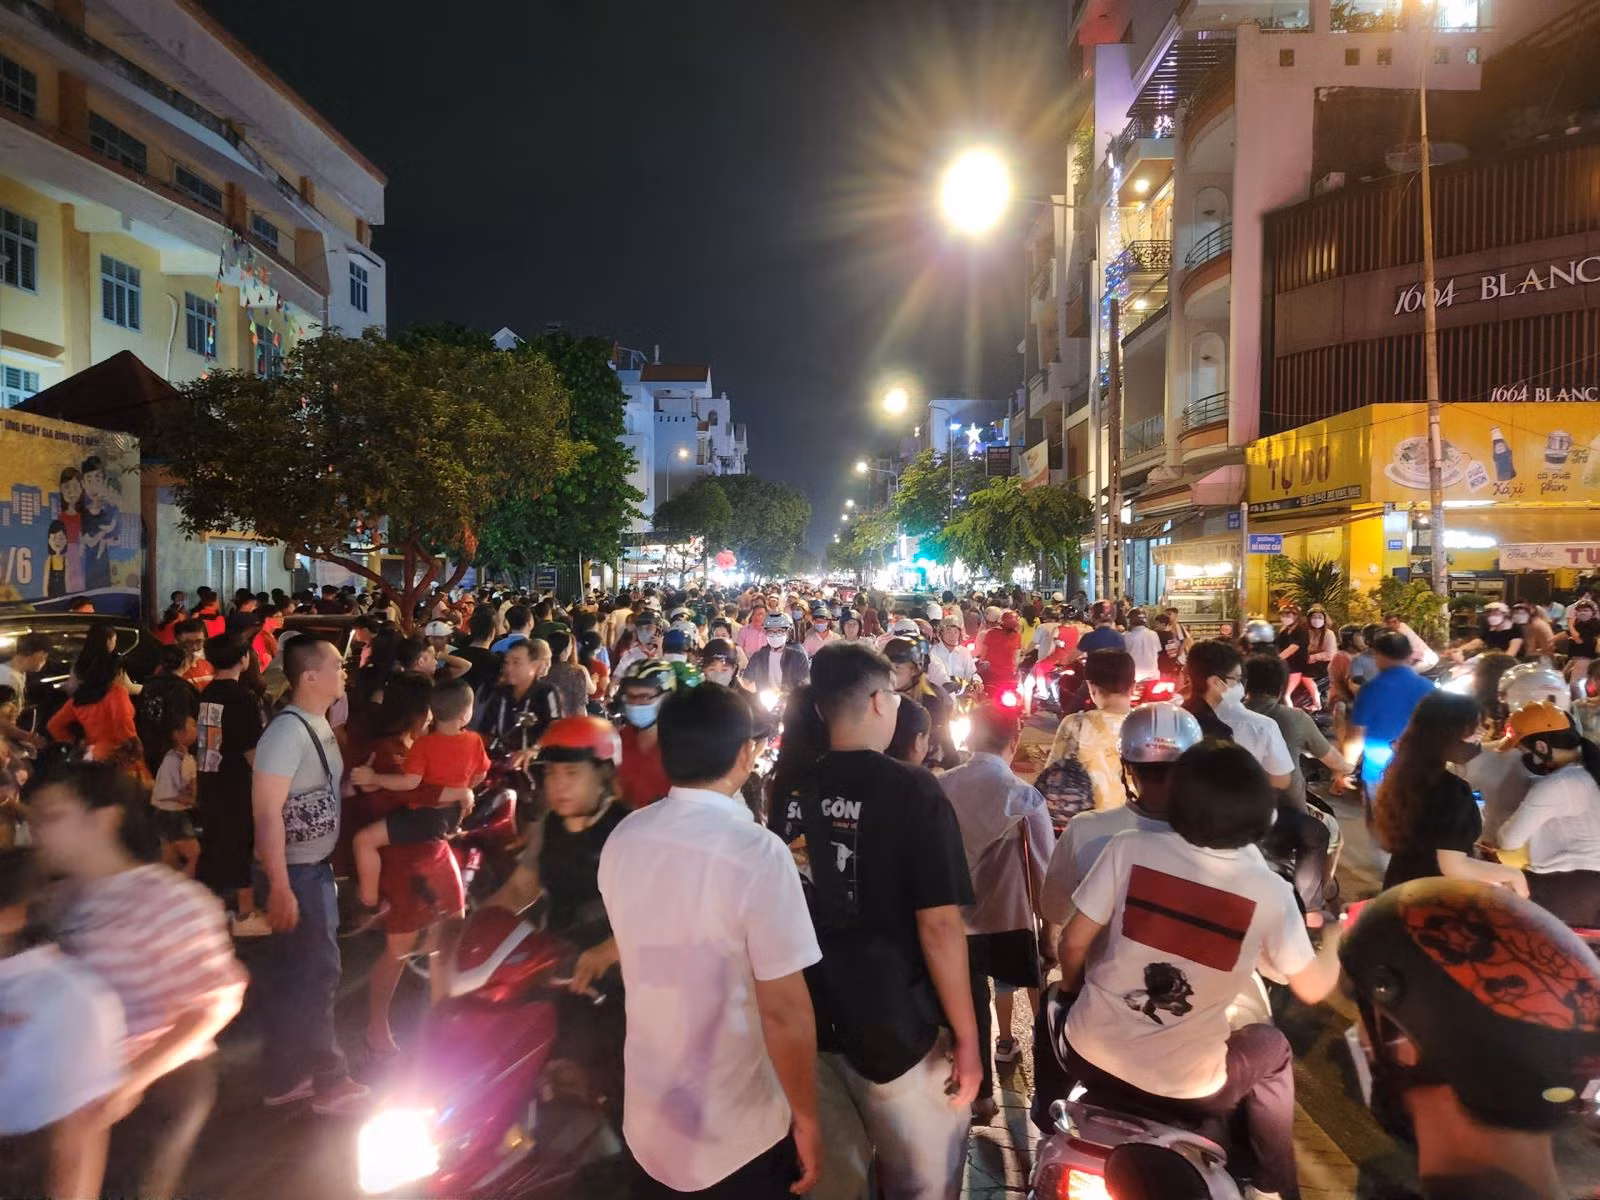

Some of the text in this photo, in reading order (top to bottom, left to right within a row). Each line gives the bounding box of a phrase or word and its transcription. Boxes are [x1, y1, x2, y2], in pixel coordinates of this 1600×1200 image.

[1480, 256, 1600, 300] BLANC
[1490, 384, 1598, 402] 1664 BLANC
[0, 546, 32, 585] /6
[821, 796, 862, 820] GÒN
